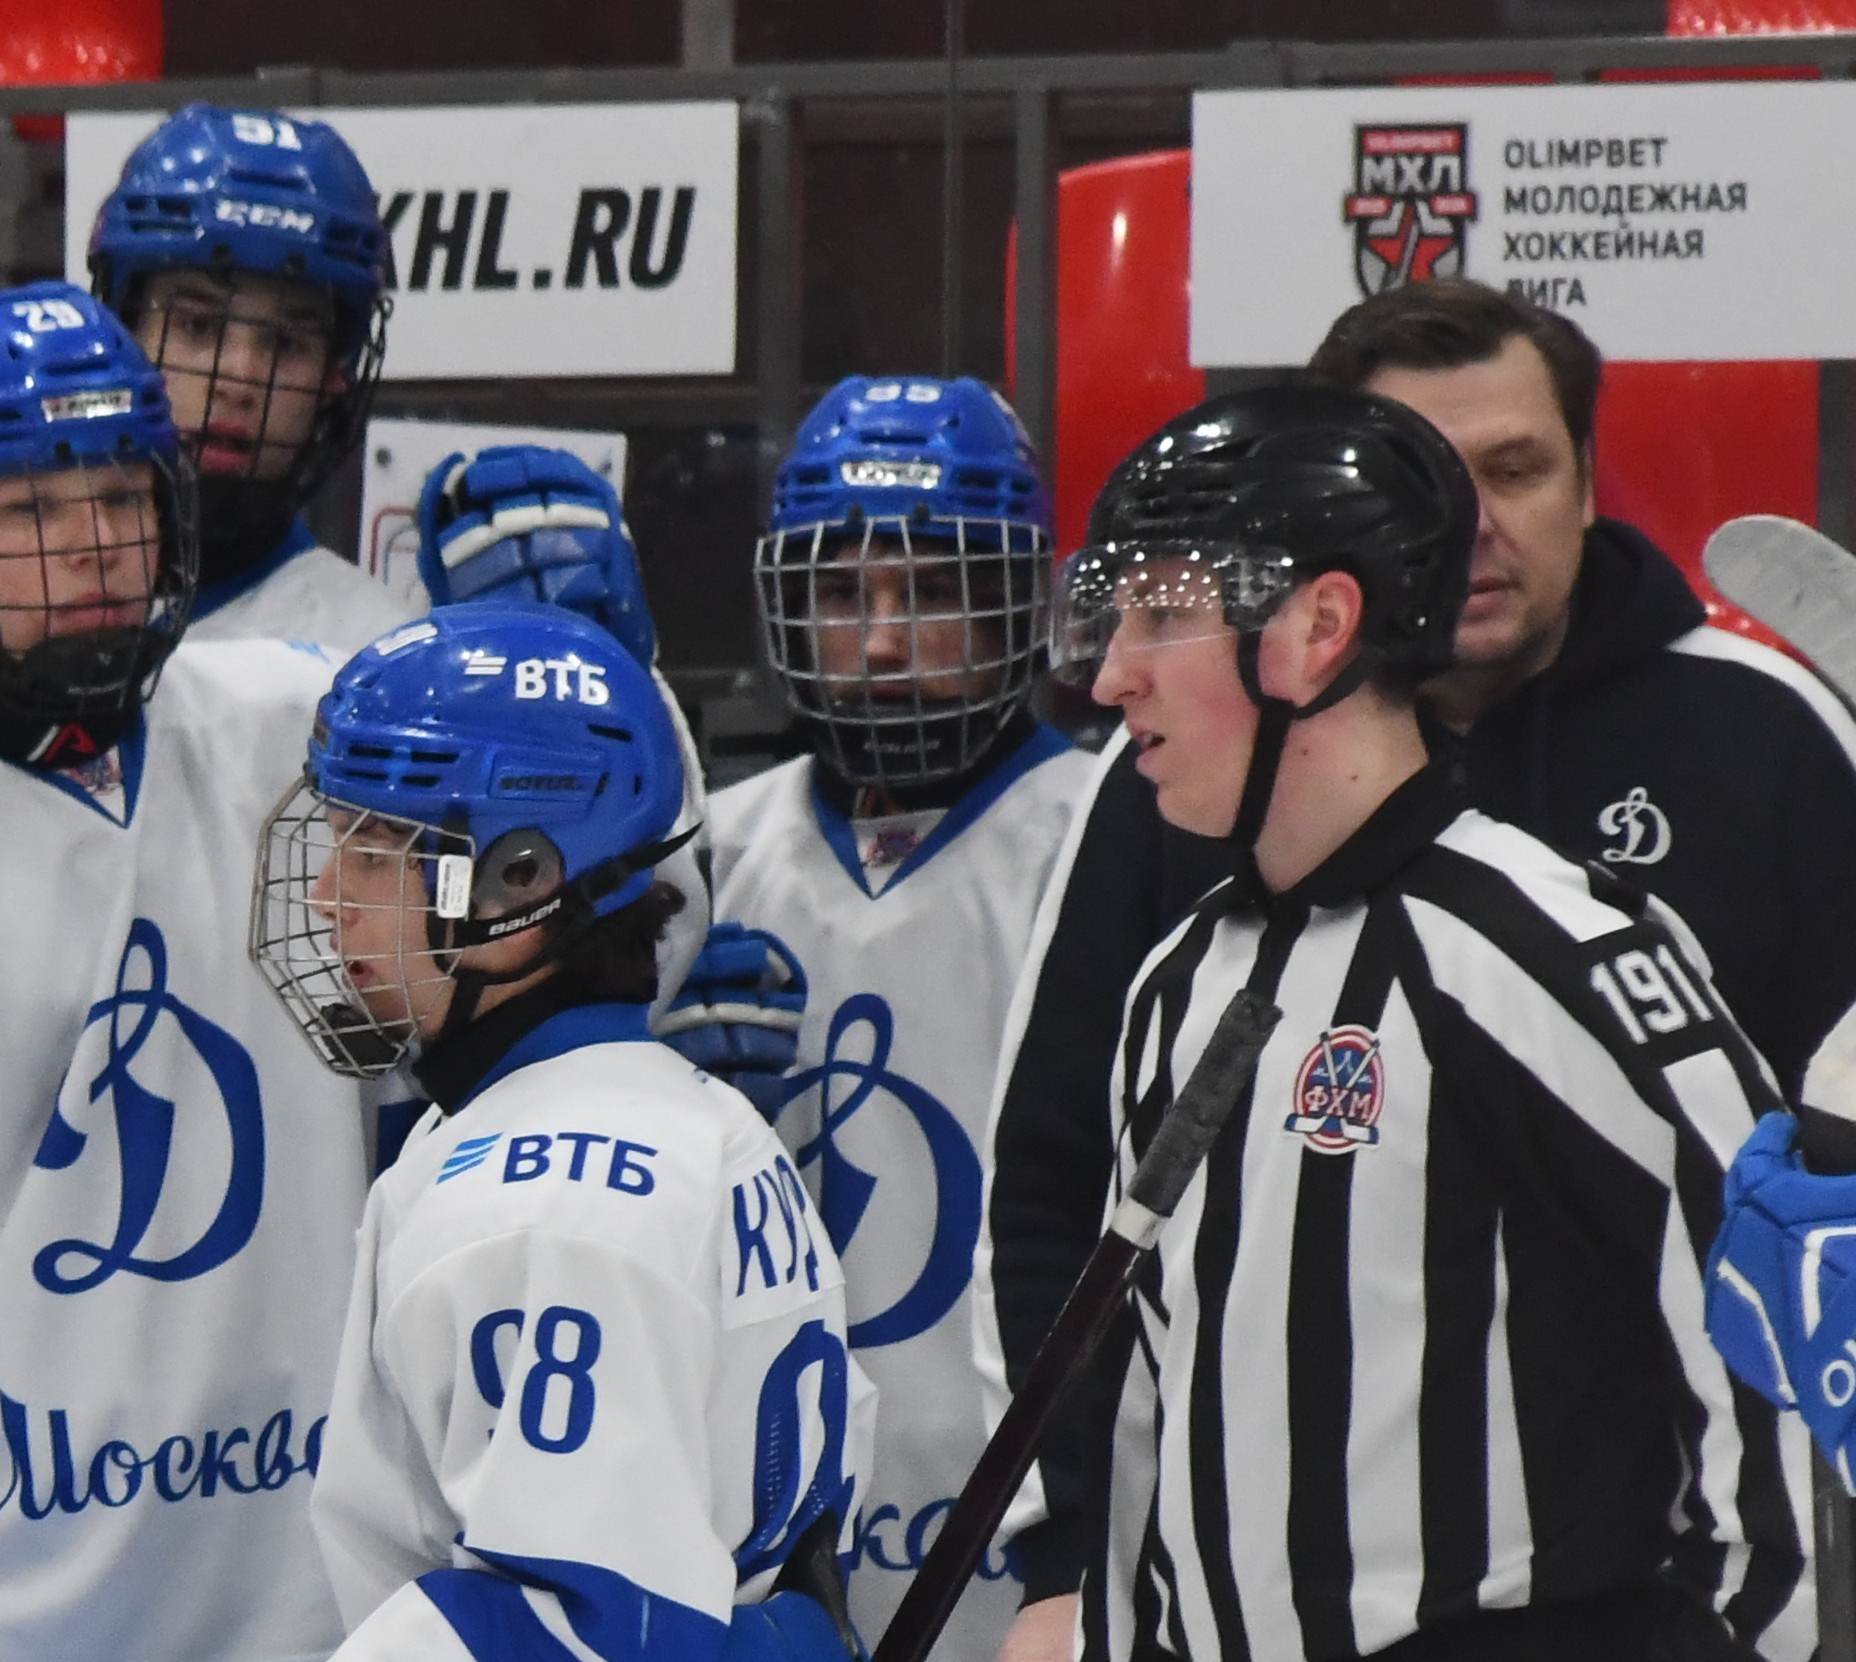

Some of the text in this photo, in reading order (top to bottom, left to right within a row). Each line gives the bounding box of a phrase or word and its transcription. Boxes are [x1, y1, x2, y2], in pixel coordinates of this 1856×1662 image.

[1503, 136, 1669, 169] OLIMPBET
[1362, 155, 1462, 194] МХЛ
[1503, 181, 1748, 219] МОЛОДЕЖНАЯ
[1503, 223, 1707, 262] ХОККЕЙНАЯ
[514, 658, 611, 706] ВТБ
[488, 898, 563, 937] BAUER
[1590, 950, 1716, 1045] 191
[1304, 1090, 1373, 1124] ФХМ
[502, 1131, 659, 1197] ВТБ
